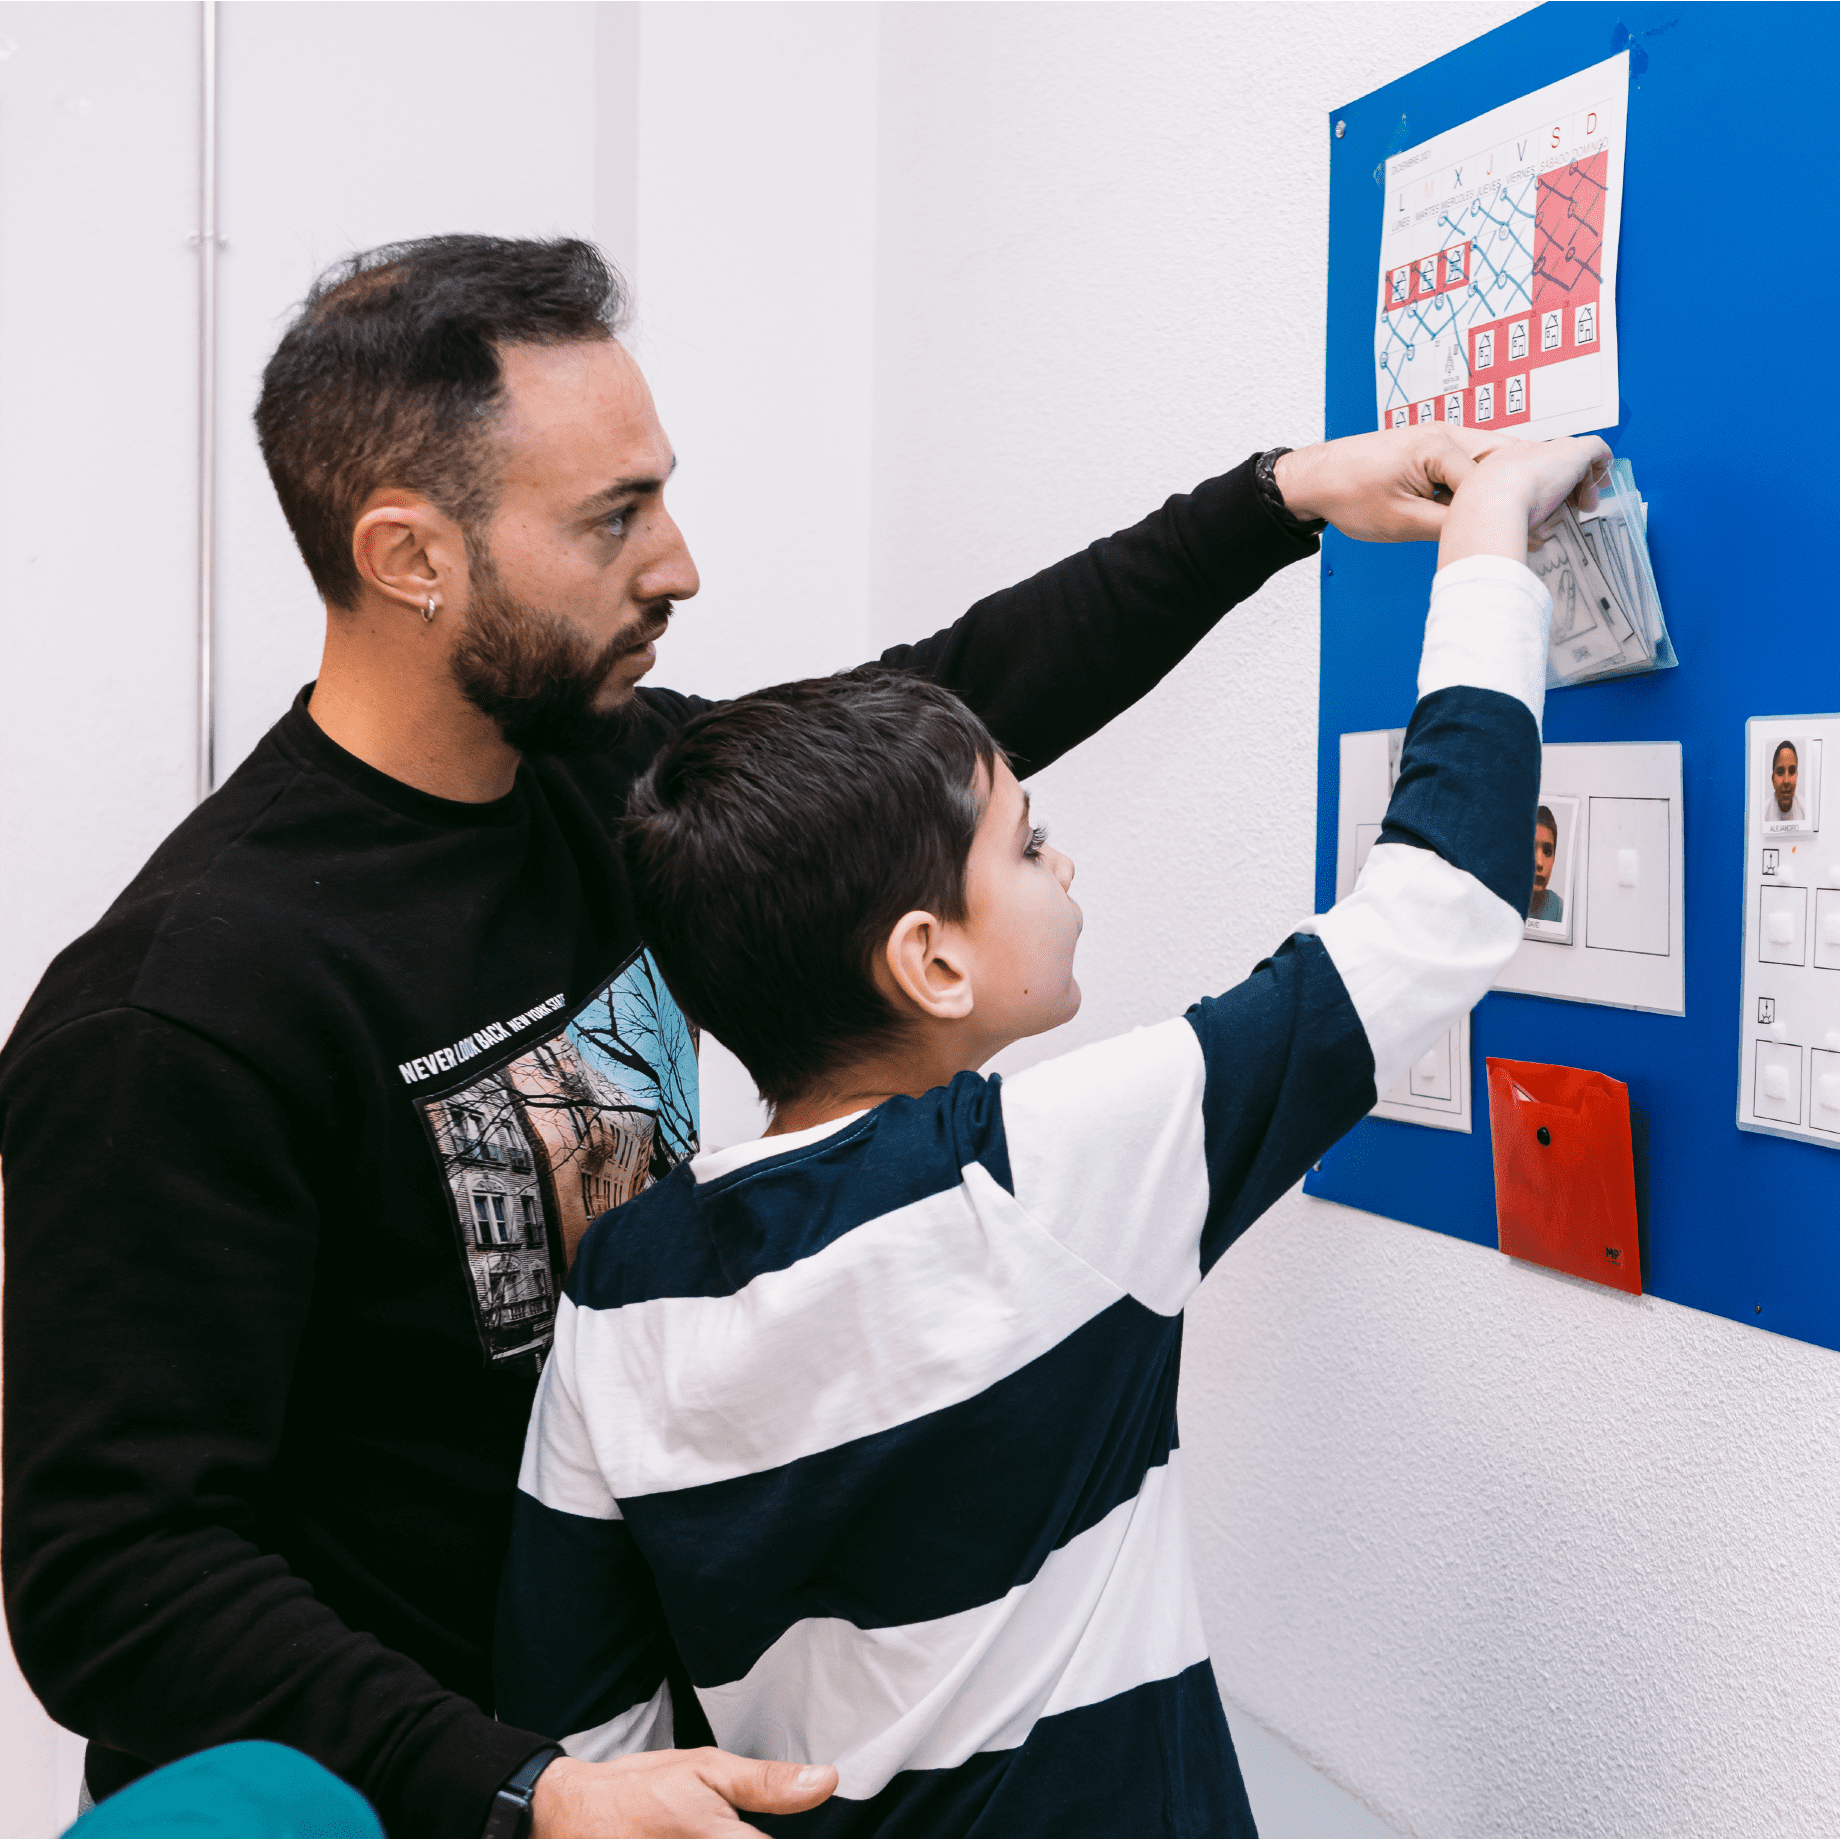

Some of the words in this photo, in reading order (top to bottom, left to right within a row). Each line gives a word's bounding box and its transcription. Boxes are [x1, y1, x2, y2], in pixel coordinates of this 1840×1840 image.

[1398, 193, 1405, 213] L
[1453, 166, 1464, 190] X
[1486, 153, 1493, 176] J
[1517, 139, 1527, 162] V
[1551, 126, 1561, 149] S
[1586, 112, 1598, 136] D
[1415, 203, 1440, 221] MARTES
[1476, 178, 1502, 197] JUEVES
[1506, 164, 1537, 185] VIERNES
[1572, 136, 1609, 160] DOMINGO
[399, 1048, 458, 1084] NEVER
[453, 1036, 482, 1063] LOOK
[473, 1021, 513, 1050] BACK
[506, 1012, 532, 1033] NEW
[525, 1002, 553, 1022] YORK
